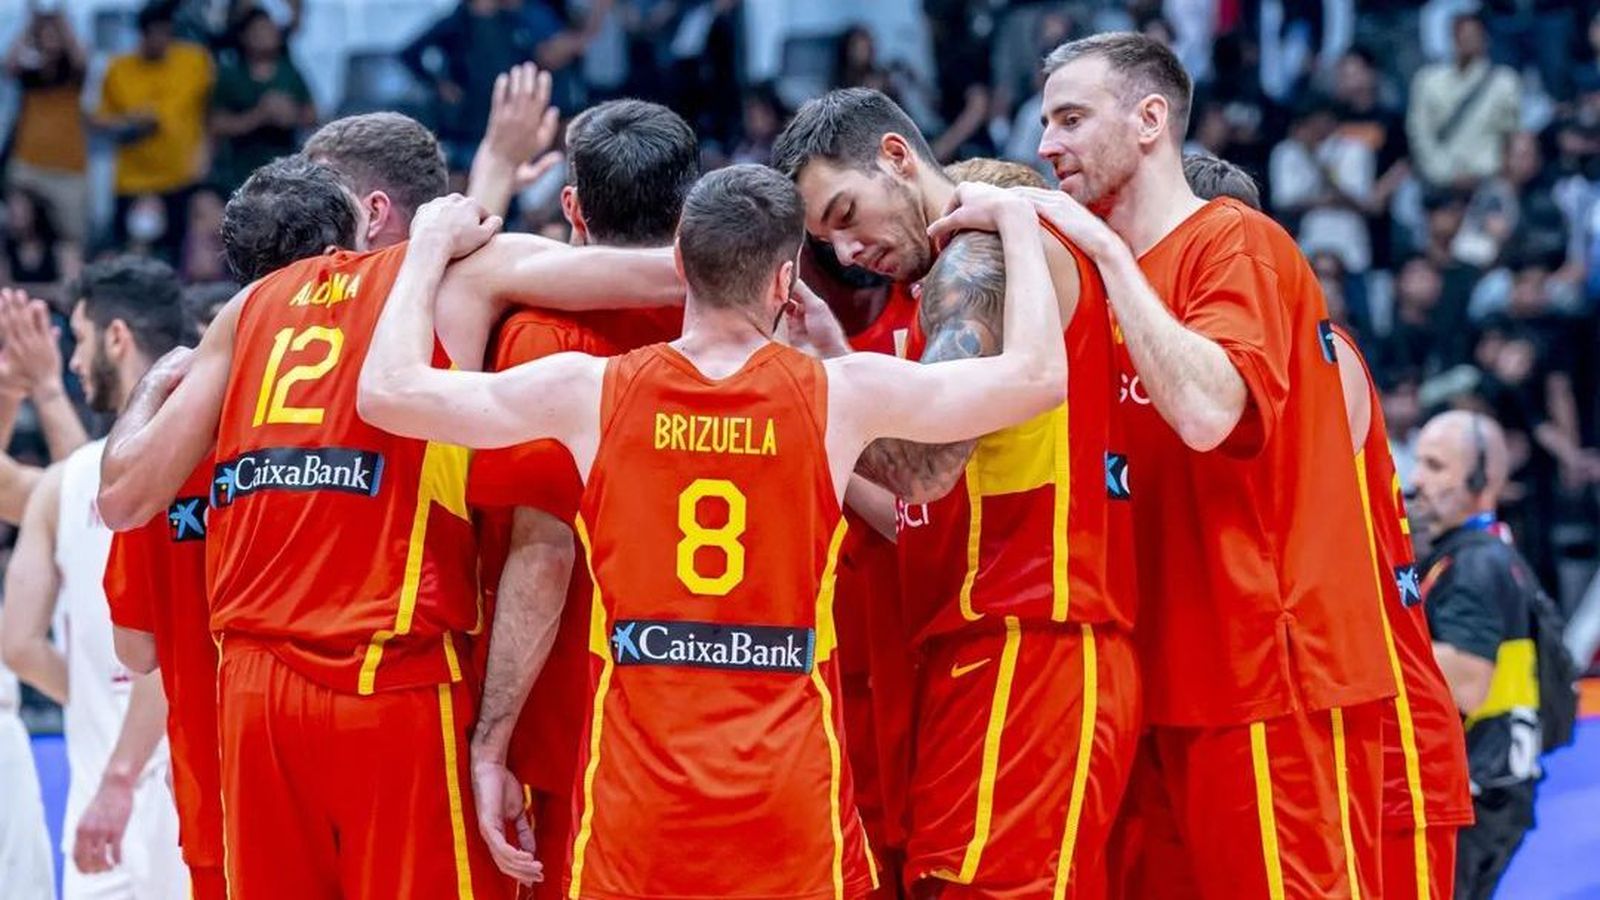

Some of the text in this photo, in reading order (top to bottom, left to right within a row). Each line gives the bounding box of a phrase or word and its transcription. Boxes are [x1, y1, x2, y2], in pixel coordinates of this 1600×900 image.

[252, 326, 344, 427] 12
[654, 413, 777, 456] BRIZUELA
[234, 454, 370, 490] CaixaBank
[677, 478, 747, 596] 8
[638, 625, 803, 667] CaixaBank
